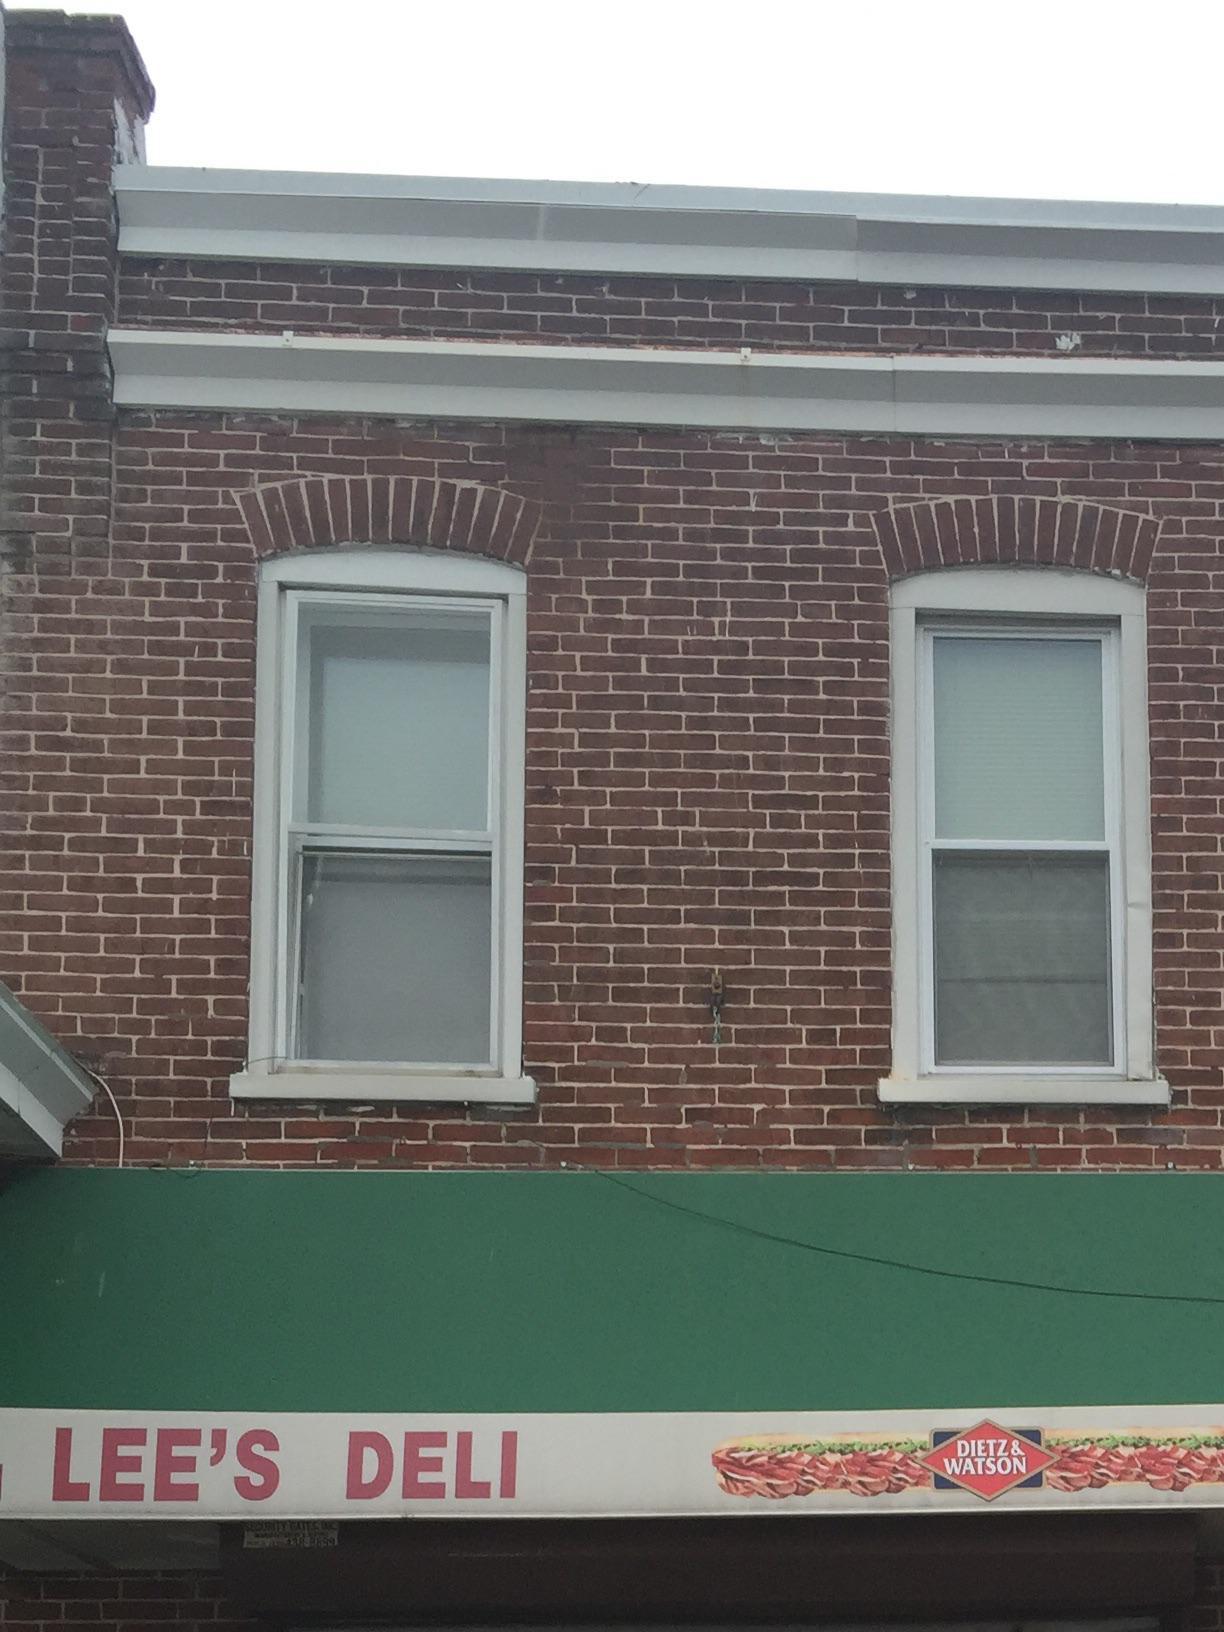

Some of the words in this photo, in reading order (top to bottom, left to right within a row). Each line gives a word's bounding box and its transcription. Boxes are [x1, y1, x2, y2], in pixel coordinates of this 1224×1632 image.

[956, 1439, 1010, 1457] DIETZ
[1010, 1439, 1026, 1457] &
[52, 1427, 281, 1502] LEE'S
[345, 1431, 518, 1500] DELI
[943, 1456, 1027, 1476] WATSON
